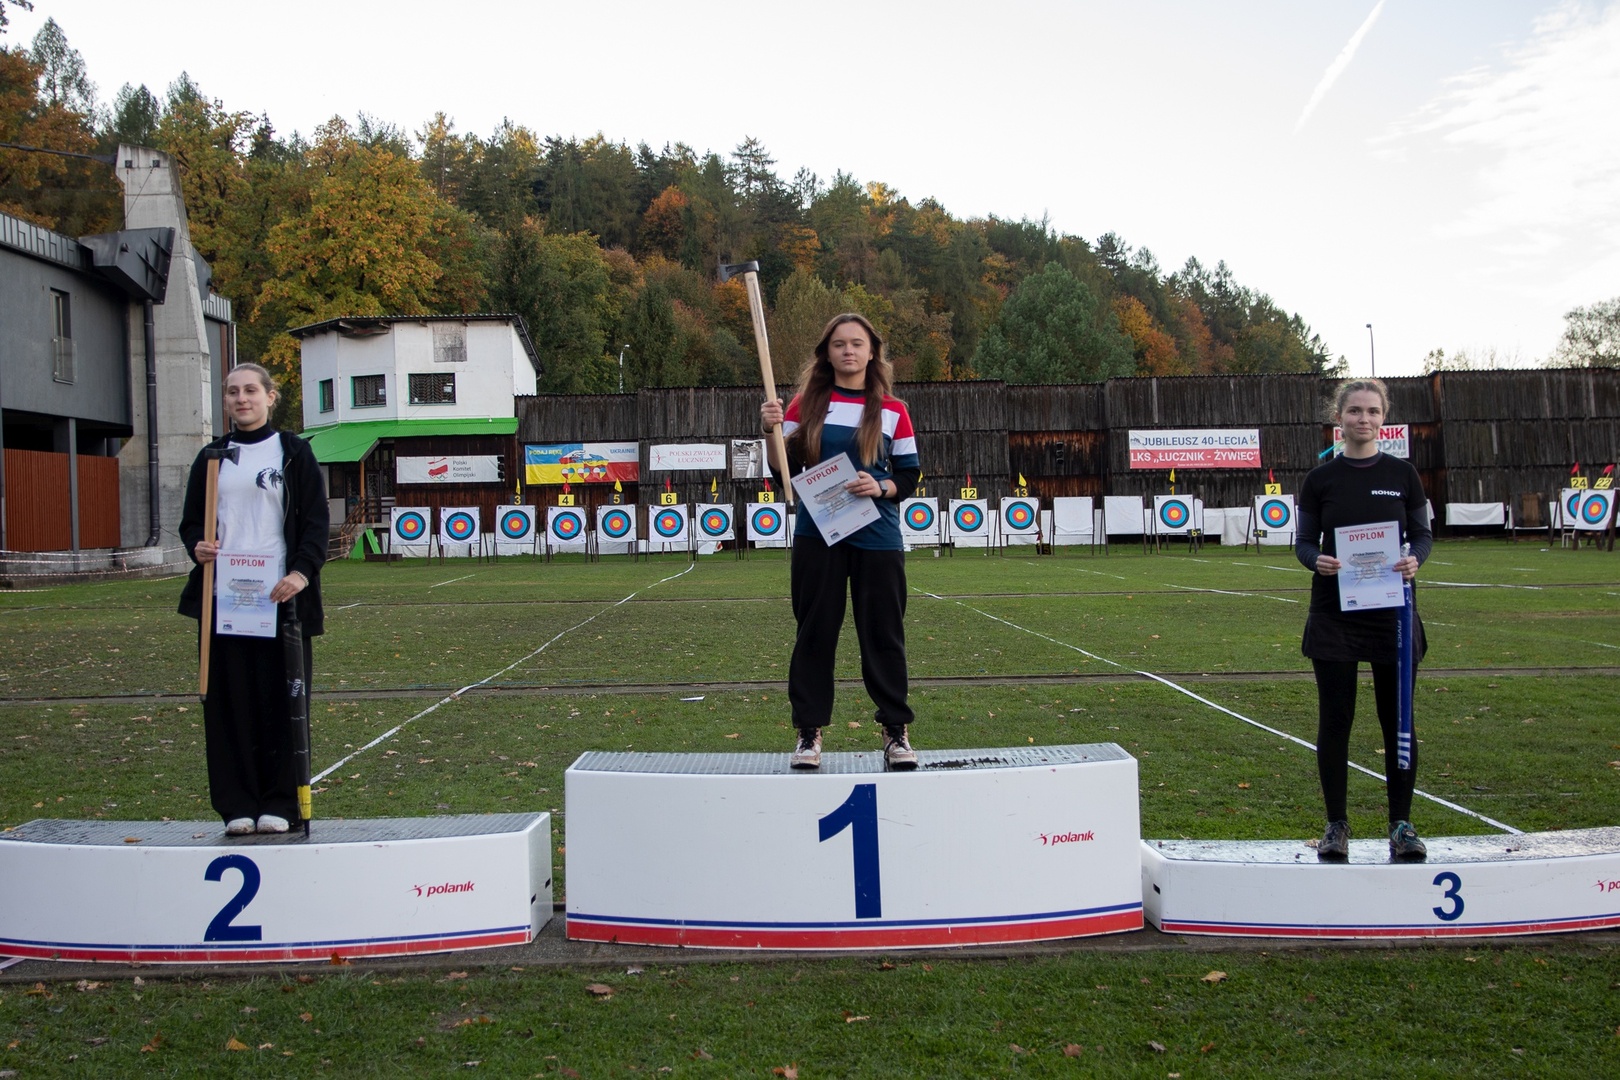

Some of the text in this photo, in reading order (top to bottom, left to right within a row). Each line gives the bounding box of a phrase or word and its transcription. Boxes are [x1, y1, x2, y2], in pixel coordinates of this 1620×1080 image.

[1142, 436, 1249, 446] JUBILEUSZ 40-LECIA
[1130, 452, 1151, 462] LKS
[806, 464, 839, 485] DYPLOM
[1572, 478, 1587, 488] 24
[1596, 479, 1611, 488] 22
[915, 487, 926, 497] 11
[962, 489, 976, 498] 12
[1014, 488, 1028, 497] 13
[1169, 485, 1175, 496] 1
[1270, 485, 1277, 494] 2
[514, 495, 521, 505] 3
[562, 495, 569, 505] 4
[613, 494, 620, 504] 5
[665, 494, 672, 503] 6
[712, 493, 719, 503] 7
[763, 493, 769, 502] 8
[1349, 531, 1385, 542] DYPLOM
[230, 558, 265, 567] DYPLOM
[1051, 830, 1094, 846] polanik
[818, 783, 882, 919] 1
[426, 880, 475, 898] polanik
[204, 854, 263, 942] 2
[1432, 871, 1465, 922] 3
